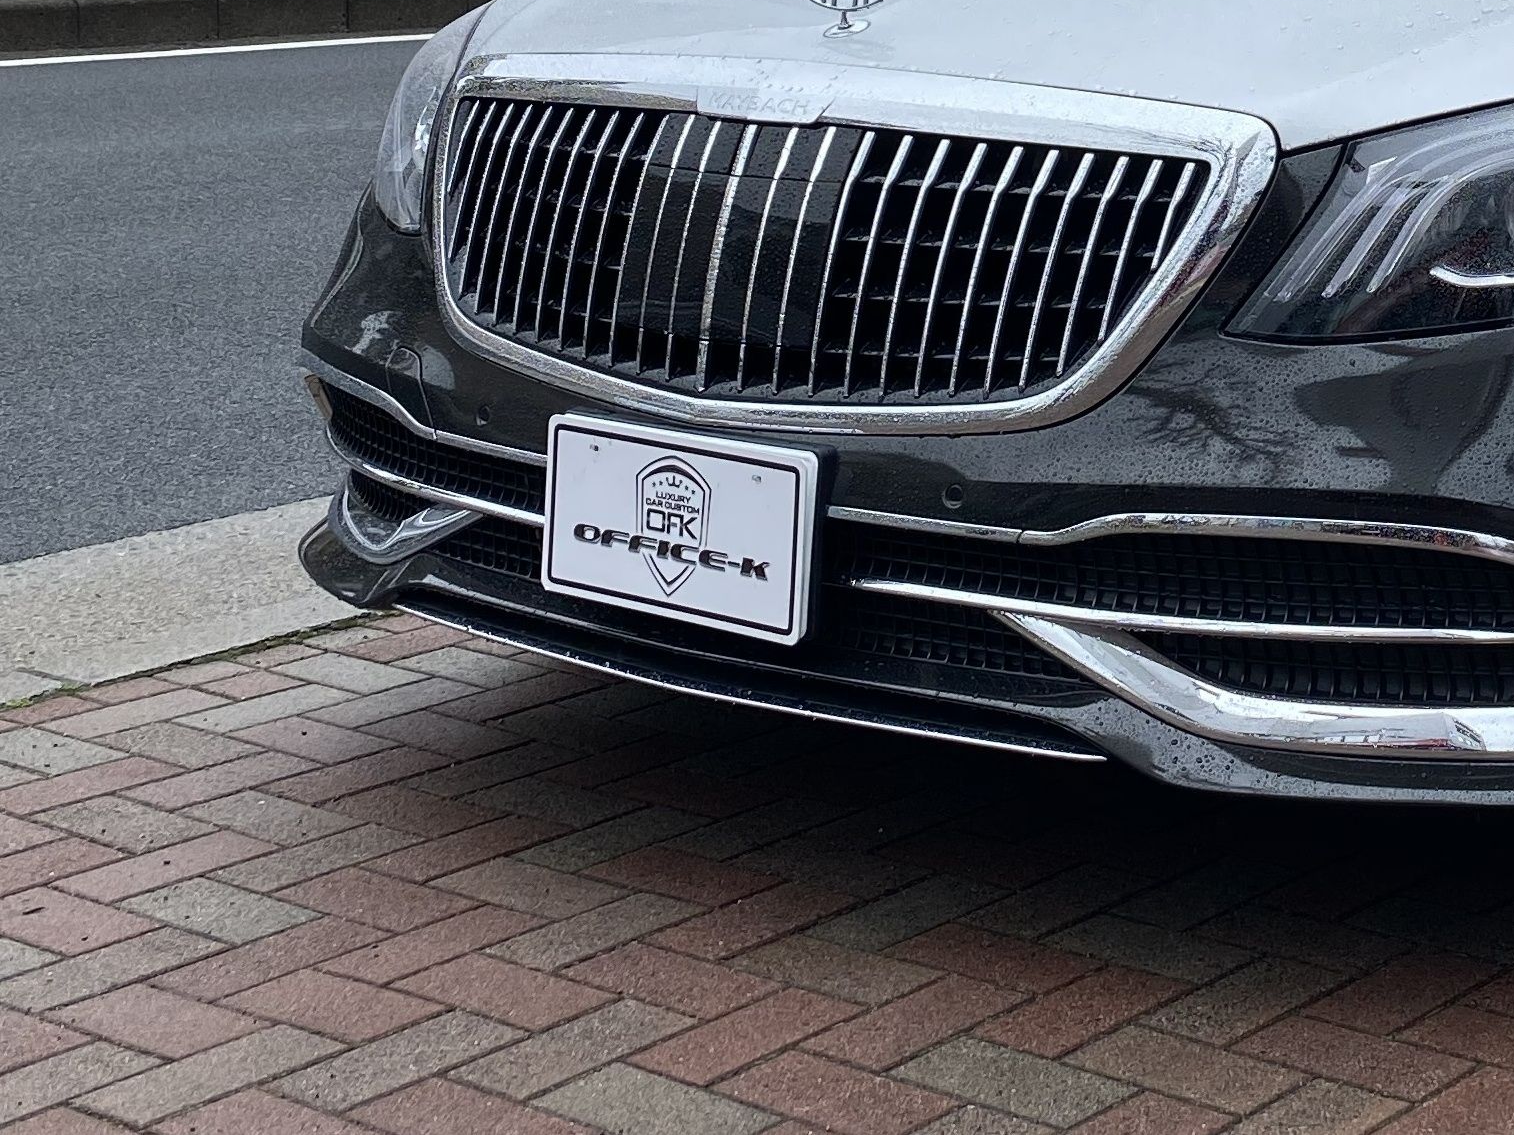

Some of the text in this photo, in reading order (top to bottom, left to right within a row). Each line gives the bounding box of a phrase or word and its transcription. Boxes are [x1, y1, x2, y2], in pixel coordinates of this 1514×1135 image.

[645, 497, 700, 516] CAR CUSTOM
[655, 490, 692, 504] LUXURY
[573, 522, 771, 582] OFFICE-K
